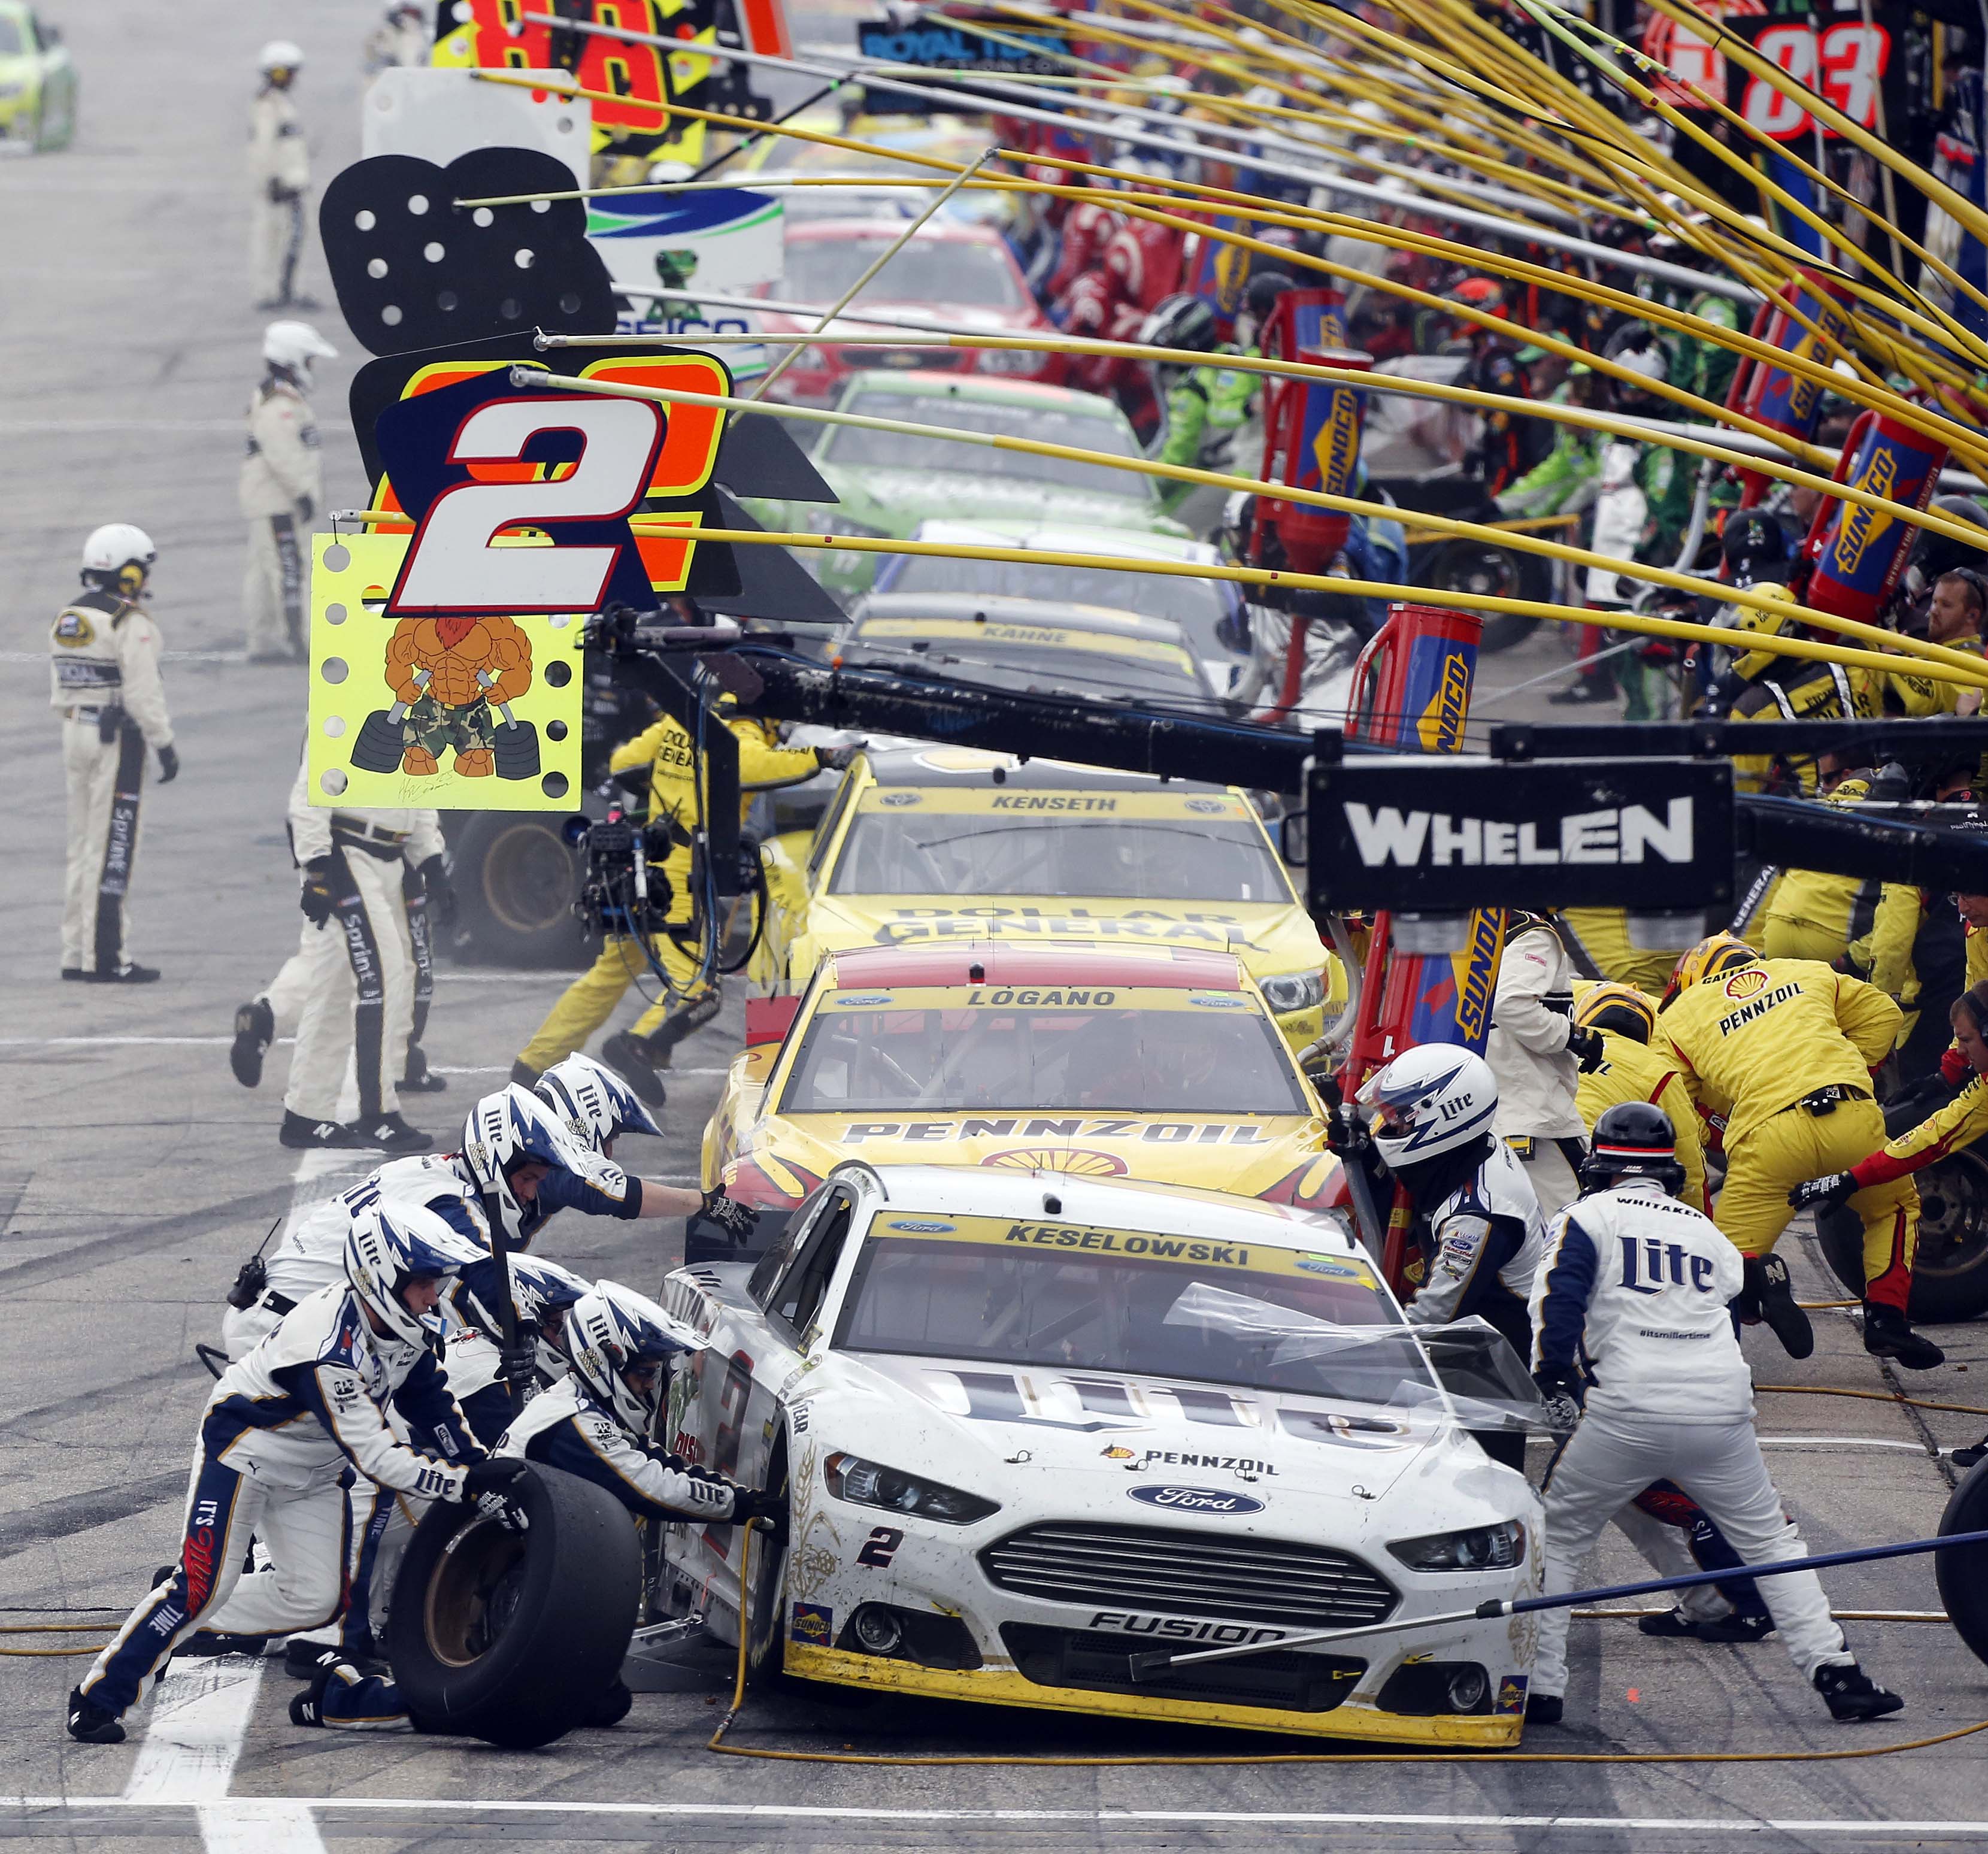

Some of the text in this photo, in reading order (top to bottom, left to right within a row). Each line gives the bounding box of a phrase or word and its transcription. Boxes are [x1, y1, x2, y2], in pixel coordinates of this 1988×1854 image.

[1741, 22, 1892, 141] 83
[389, 395, 662, 612] 2
[1838, 450, 1895, 571] SUNCO
[982, 626, 1068, 644] KAHNE
[992, 795, 1119, 812] KENSETH
[1343, 796, 1694, 867] WHELEN
[890, 907, 1240, 925] DOLLAR
[344, 913, 377, 982] Sprint
[872, 917, 1271, 953] GENERAL
[967, 990, 1115, 1007] LOGANO
[1718, 982, 1805, 1038] PENNZOIL
[575, 1082, 602, 1119] Lite
[1438, 1092, 1474, 1122] Lite
[484, 1108, 503, 1143] Lite
[843, 1117, 1276, 1144] PENNZOIL
[1617, 1197, 1703, 1219] WHITAKER
[358, 1229, 381, 1267] Lite
[1004, 1224, 1250, 1266] KESELOWSKI
[1616, 1235, 1715, 1295] Lite
[1145, 1450, 1281, 1476] PENNZOIL
[416, 1467, 456, 1495] Lite
[687, 1480, 725, 1505] Lite
[195, 1500, 219, 1526] IT'S
[856, 1526, 904, 1568] 2
[149, 1604, 184, 1637] TIME
[793, 1616, 831, 1634] SUNOCO
[1089, 1611, 1287, 1644] FUSION
